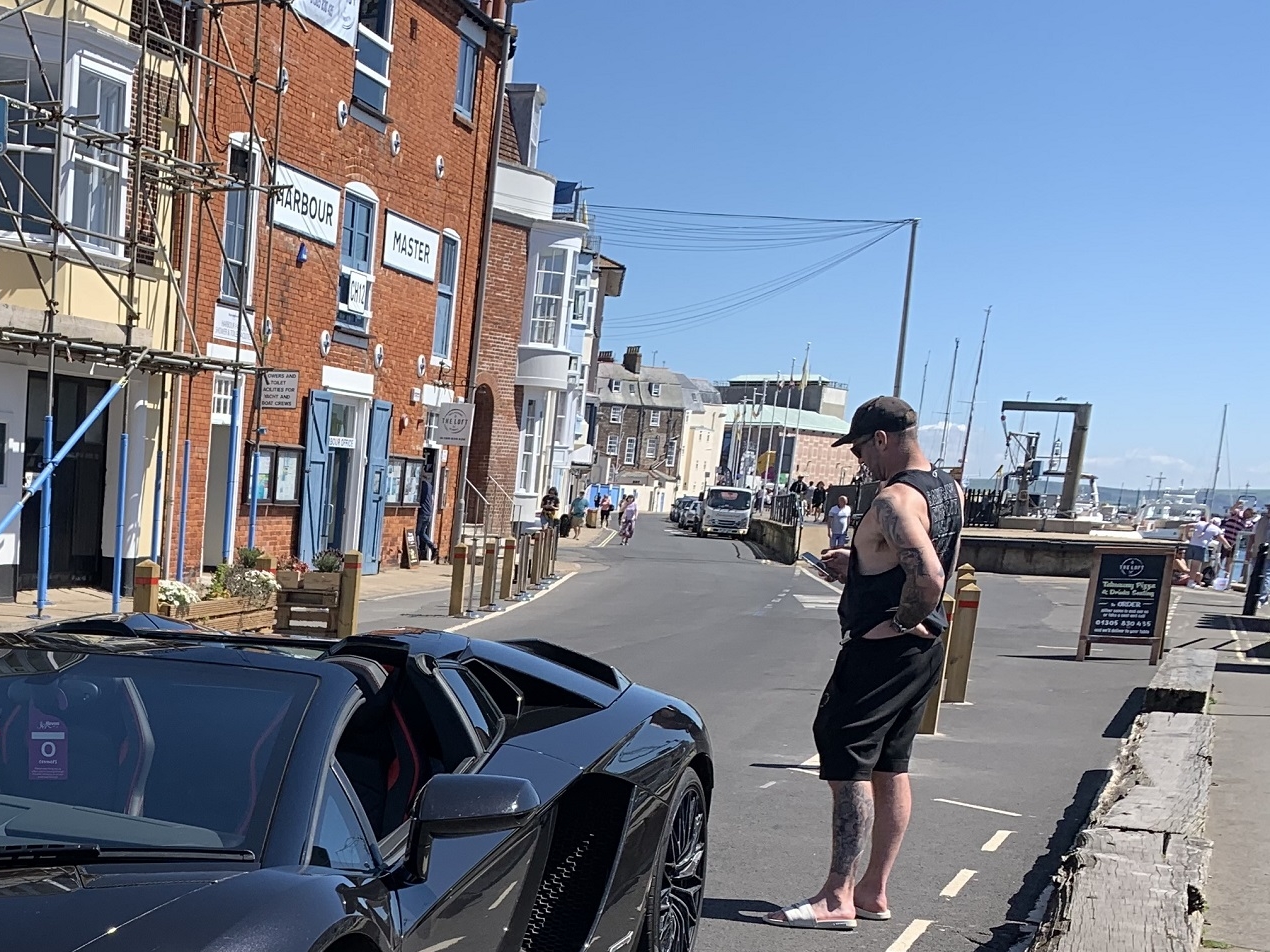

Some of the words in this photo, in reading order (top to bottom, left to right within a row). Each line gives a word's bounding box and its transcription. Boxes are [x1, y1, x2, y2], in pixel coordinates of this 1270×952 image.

[276, 181, 334, 227] HARBOUR
[392, 230, 431, 264] MASTER
[442, 417, 453, 425] THE
[1135, 582, 1157, 591] Pizza
